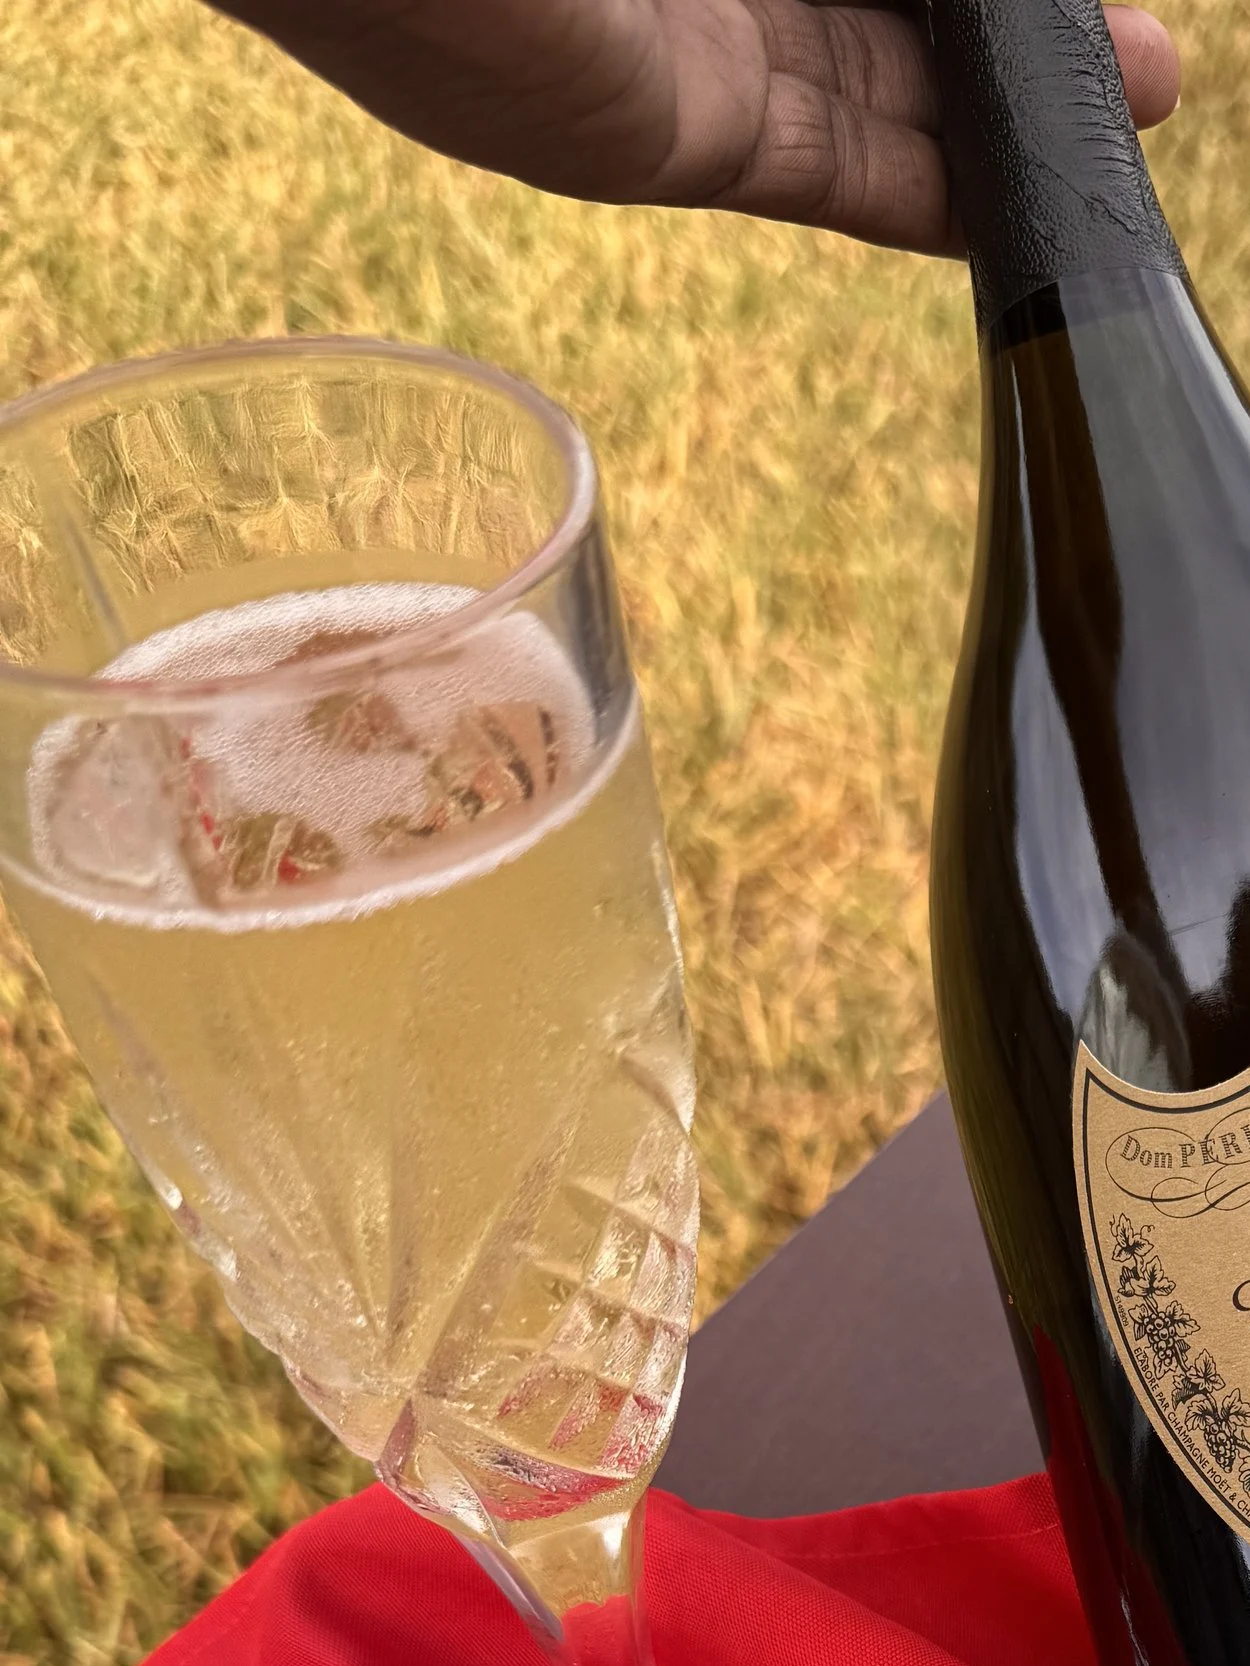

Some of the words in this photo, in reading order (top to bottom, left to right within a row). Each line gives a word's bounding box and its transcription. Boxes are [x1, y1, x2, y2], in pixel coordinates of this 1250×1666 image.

[1120, 1135, 1172, 1168] Dom
[1155, 1391, 1170, 1412] PAR
[1167, 1411, 1210, 1470] CHAMPAGNE
[1206, 1467, 1232, 1493] MOËT
